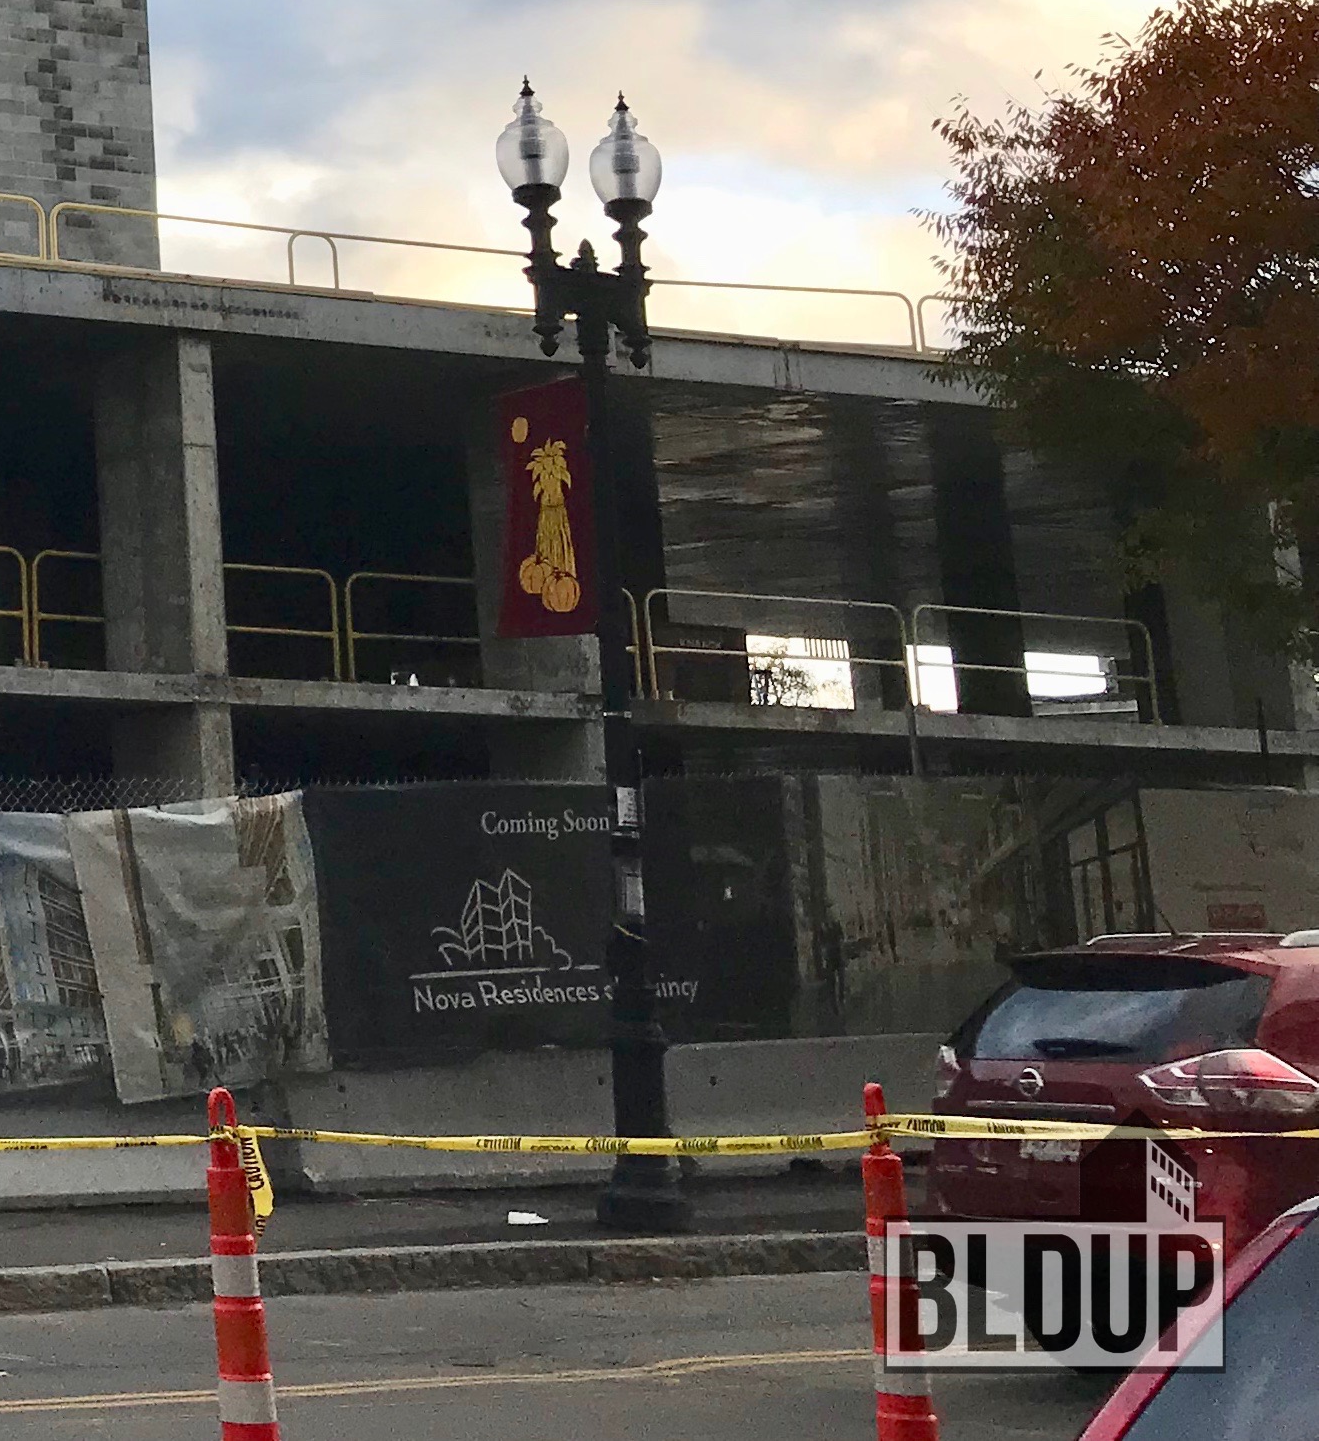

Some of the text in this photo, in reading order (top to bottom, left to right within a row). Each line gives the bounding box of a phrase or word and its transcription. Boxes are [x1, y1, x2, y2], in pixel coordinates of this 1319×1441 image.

[480, 809, 611, 839] Coming Soon
[413, 985, 476, 1013] Nova
[478, 976, 600, 1007] Residences
